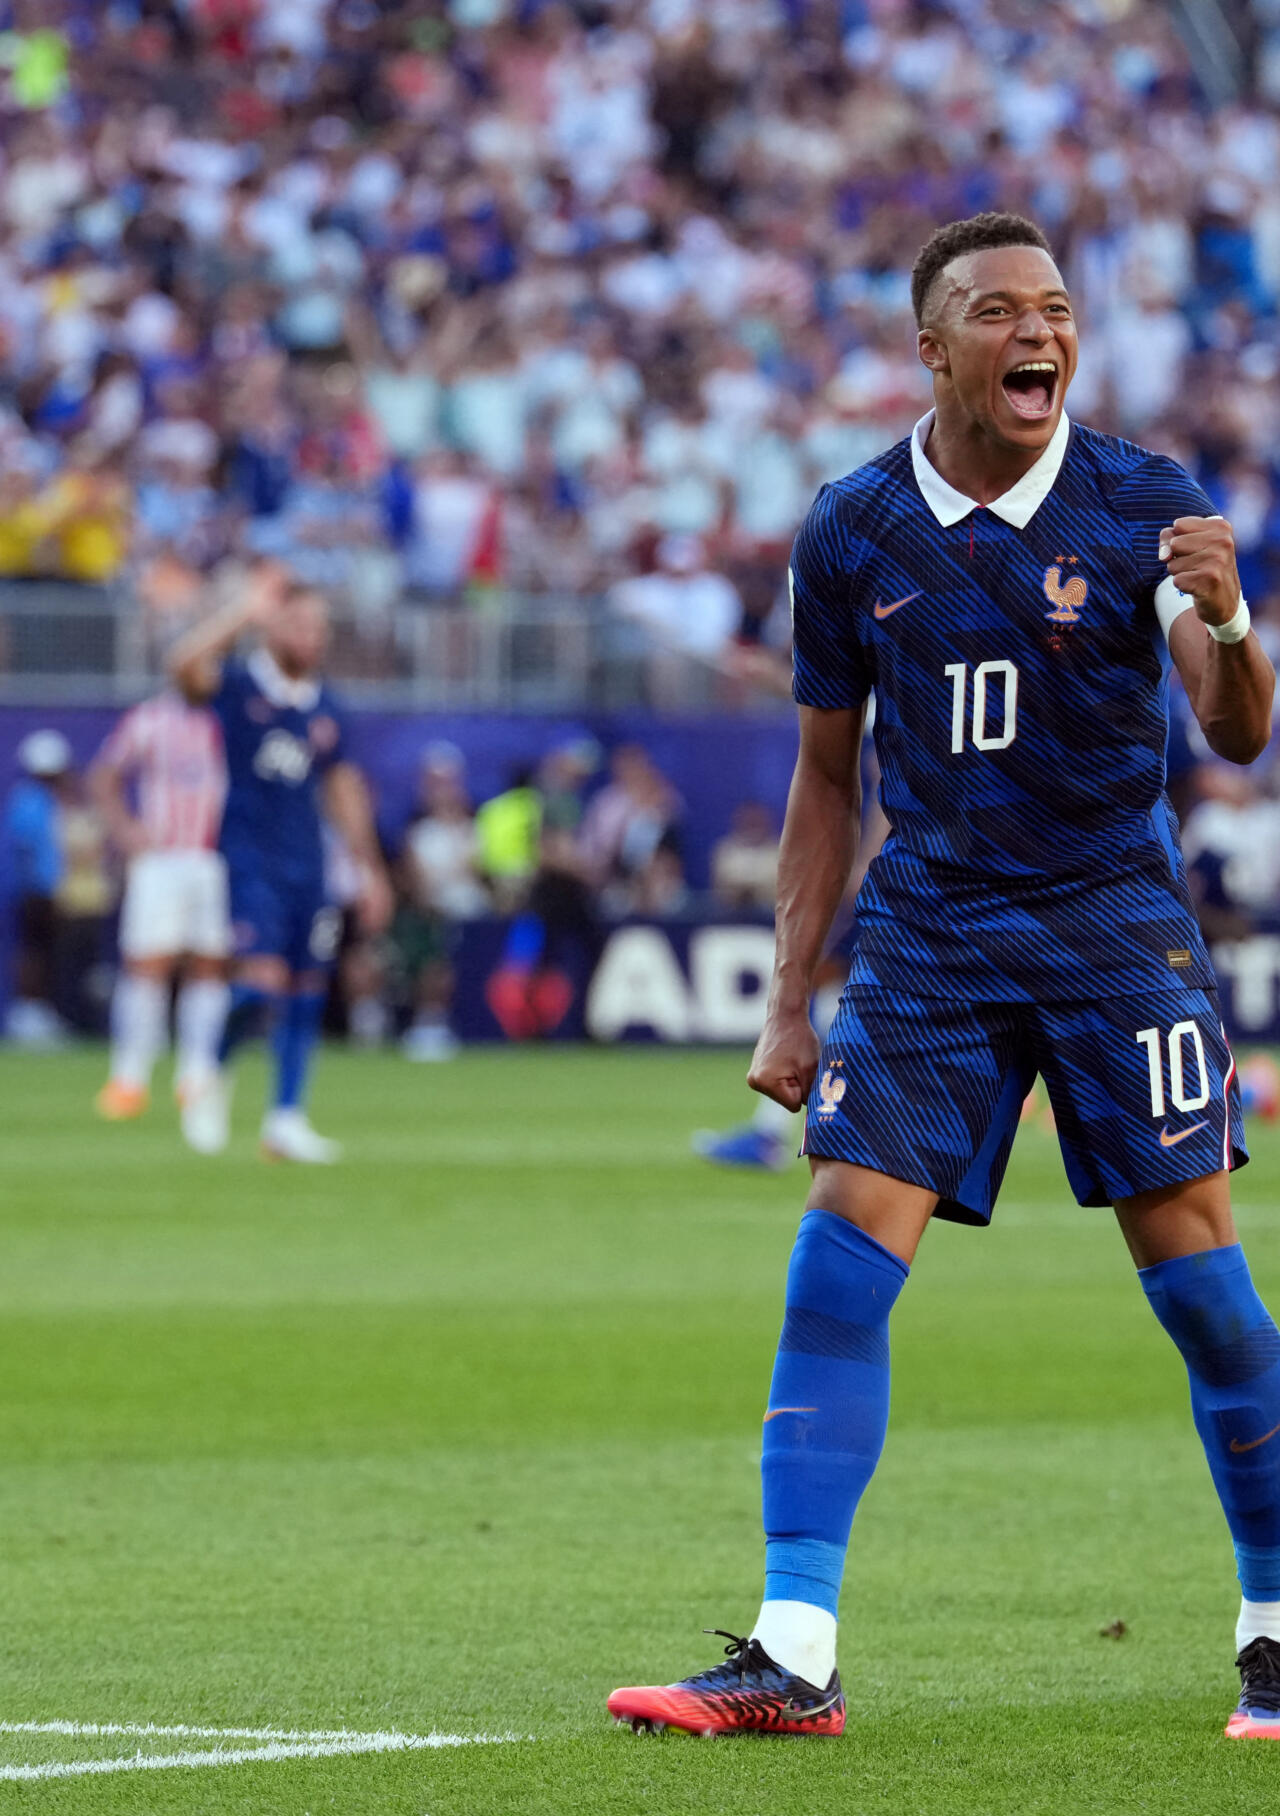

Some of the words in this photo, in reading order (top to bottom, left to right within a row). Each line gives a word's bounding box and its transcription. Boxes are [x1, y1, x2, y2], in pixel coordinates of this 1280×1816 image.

[944, 660, 1019, 754] 10
[586, 926, 775, 1041] AD
[1136, 1020, 1210, 1118] 10
